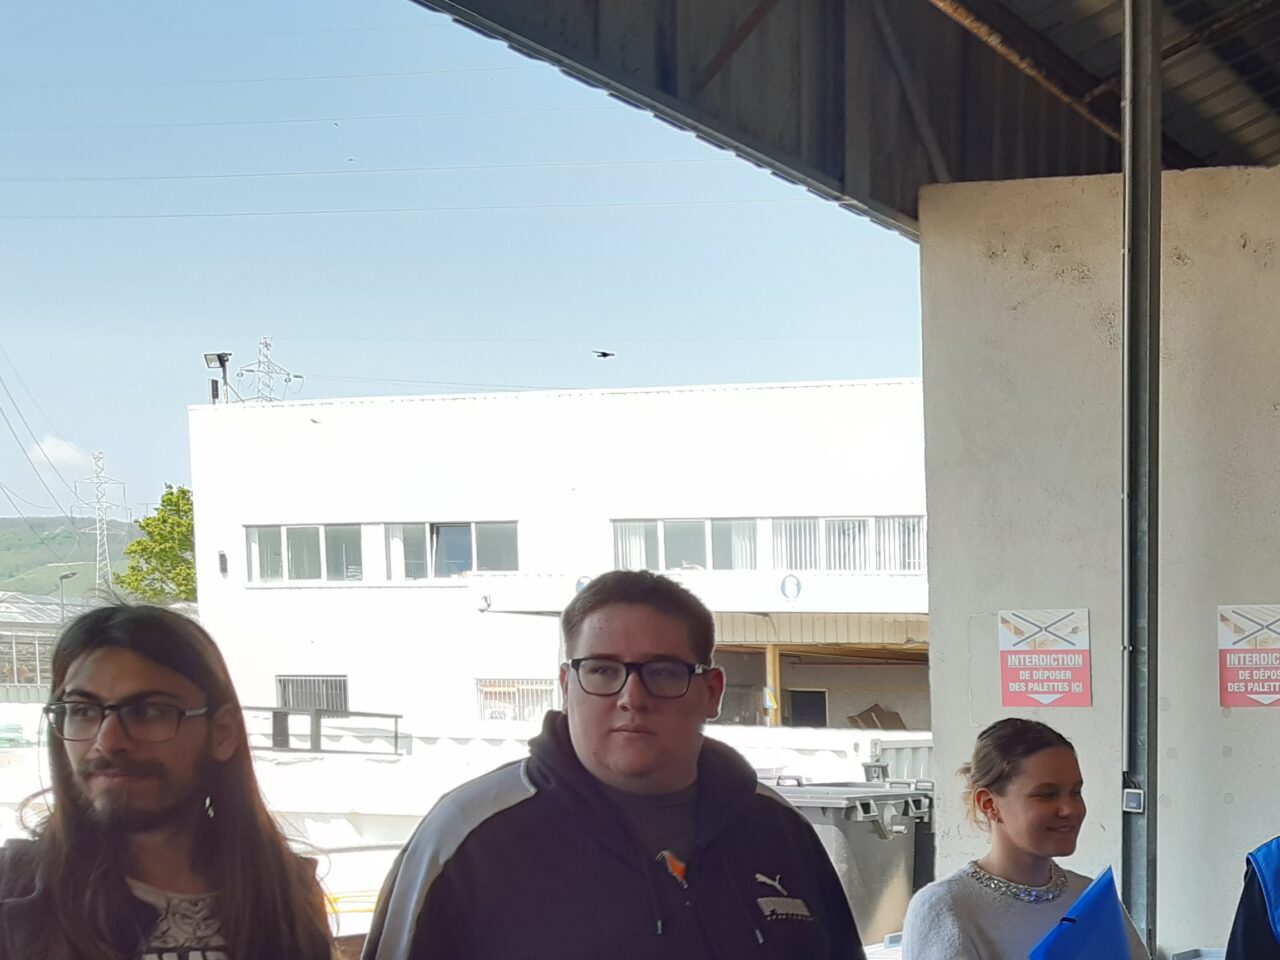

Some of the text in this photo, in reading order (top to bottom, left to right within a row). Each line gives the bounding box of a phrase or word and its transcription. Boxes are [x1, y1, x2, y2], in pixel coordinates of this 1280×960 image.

[1007, 654, 1082, 667] INTERDICTION
[1019, 668, 1072, 680] DE DÉPOSER
[1238, 670, 1251, 680] DE
[1009, 682, 1083, 693] DES PALETTES ICI
[1228, 682, 1245, 692] DES
